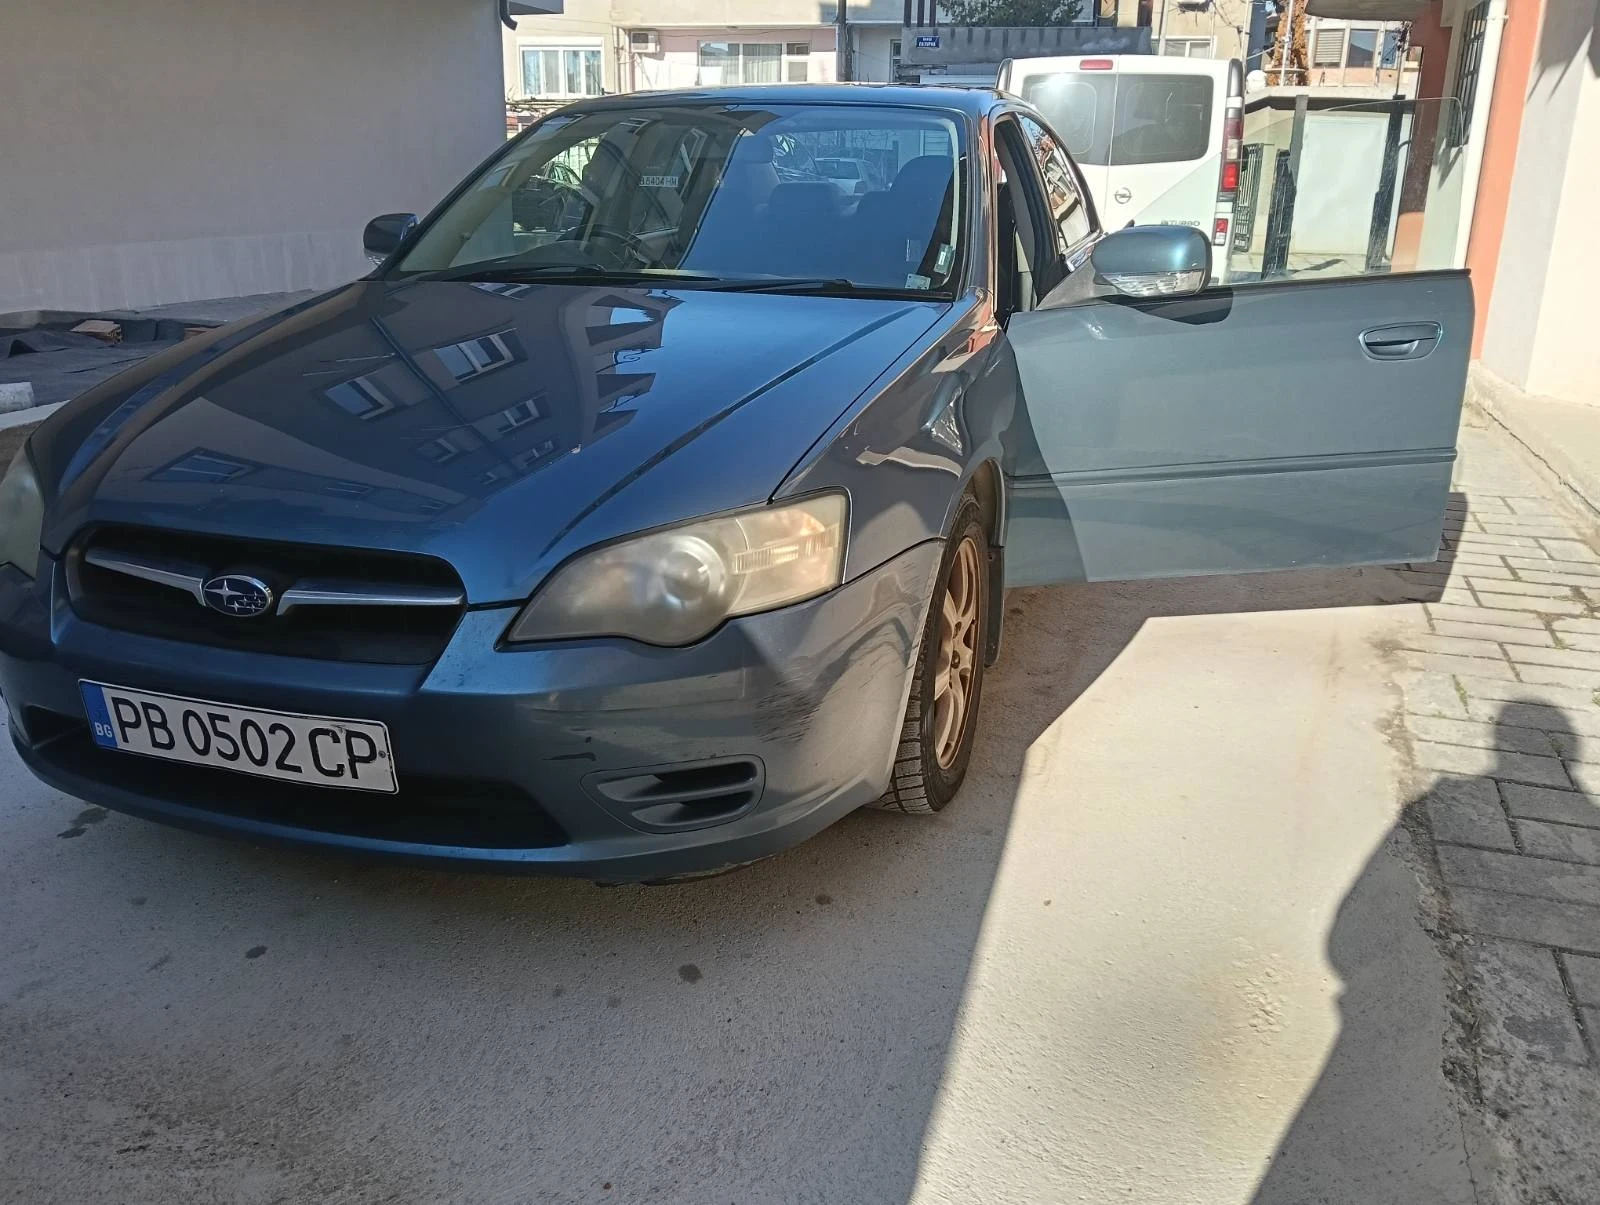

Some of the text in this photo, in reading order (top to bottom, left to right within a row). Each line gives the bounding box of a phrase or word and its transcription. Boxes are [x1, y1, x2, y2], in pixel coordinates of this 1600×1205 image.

[94, 721, 113, 738] BG
[111, 696, 378, 780] PB 0502 CP
